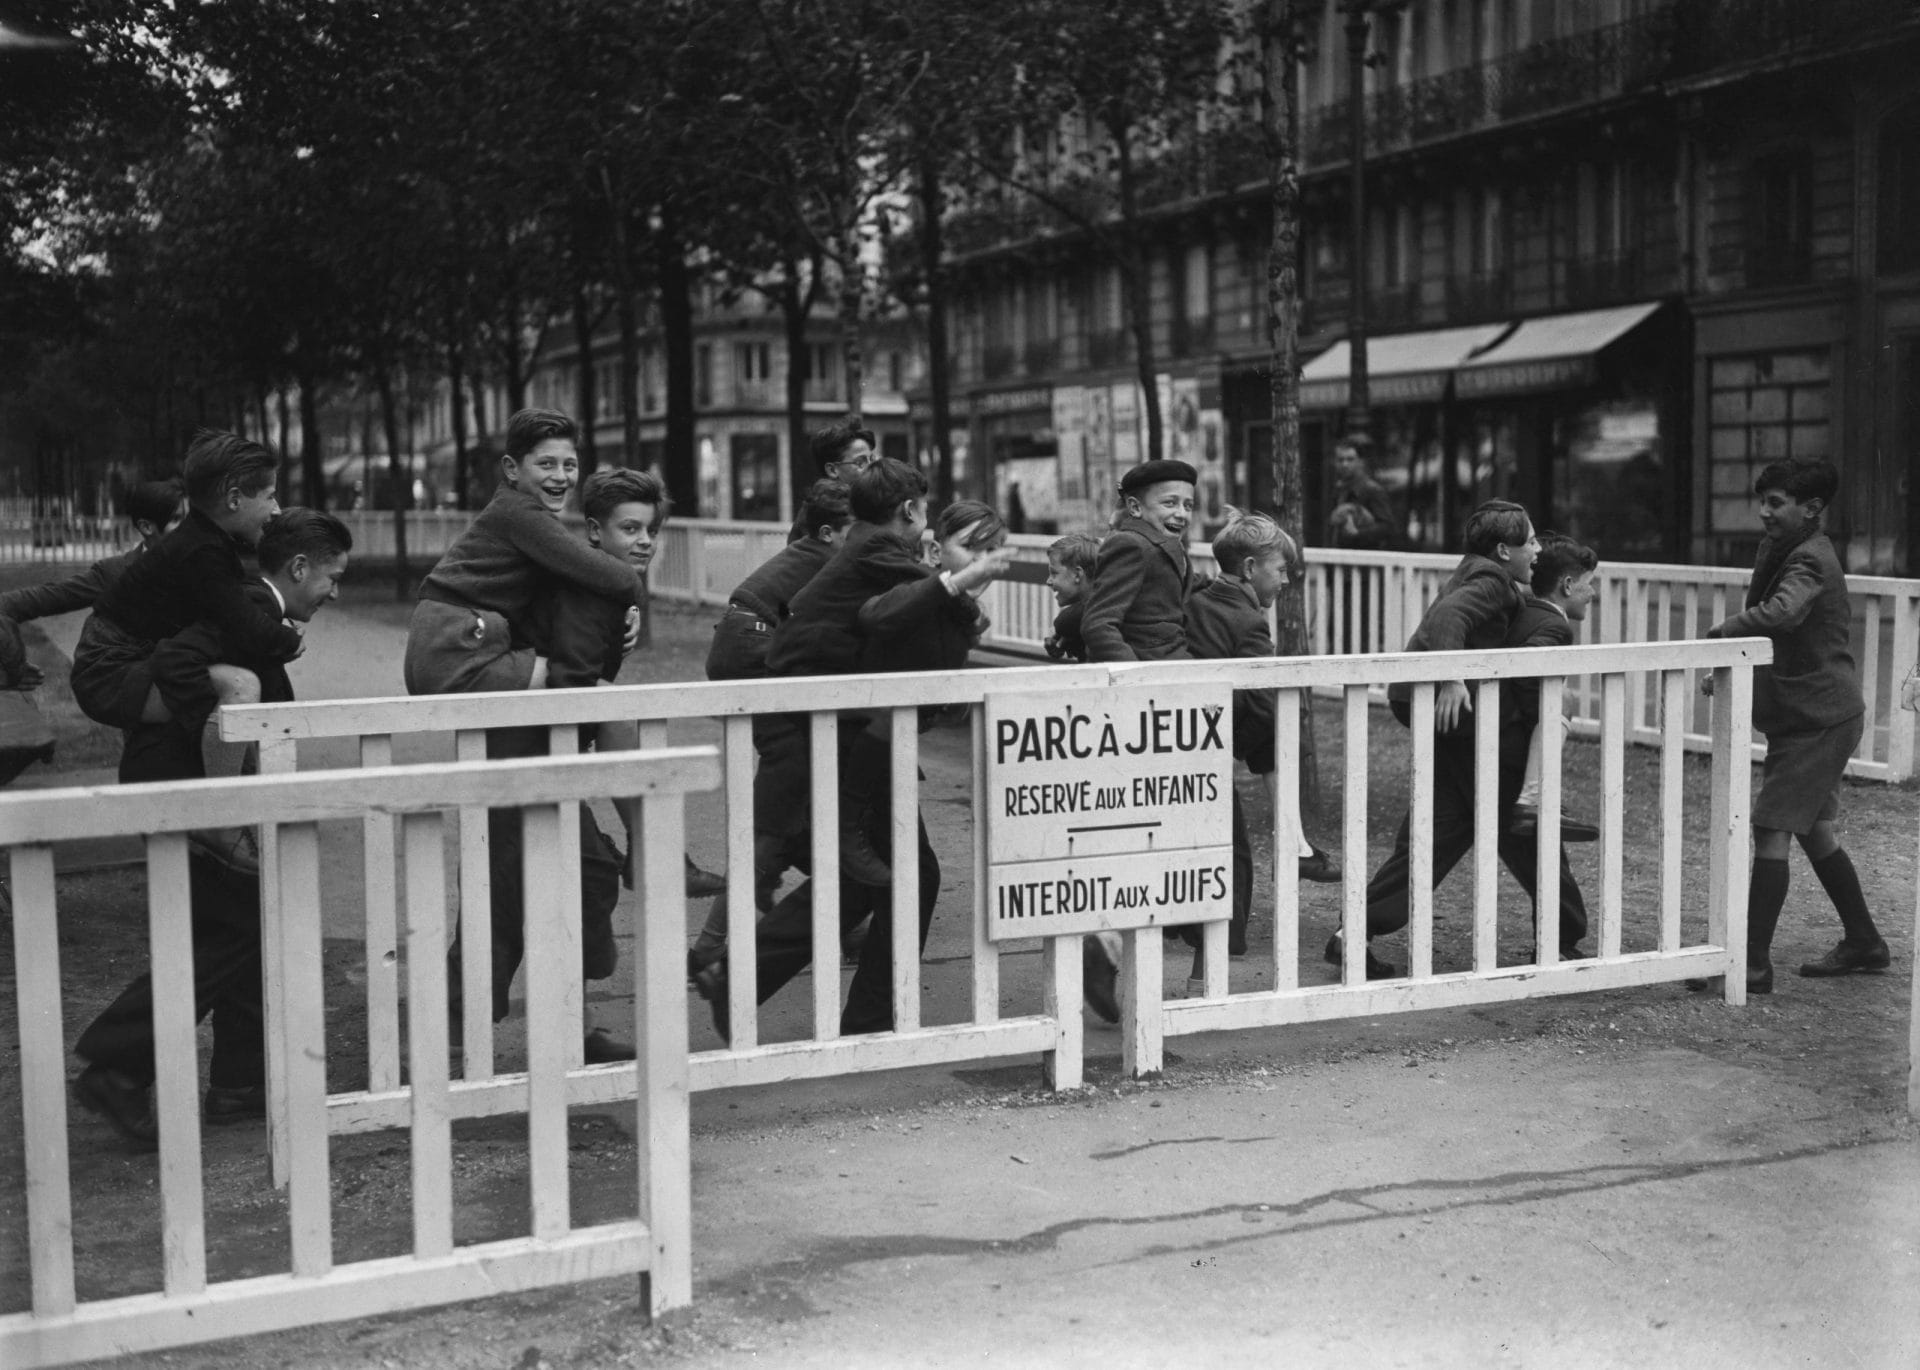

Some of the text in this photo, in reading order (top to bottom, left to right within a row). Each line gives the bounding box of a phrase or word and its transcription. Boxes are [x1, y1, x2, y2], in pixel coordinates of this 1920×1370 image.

[997, 707, 1224, 764] PARC À JEUX
[1005, 773, 1218, 817] RÉSERVÉ AUX ENFANTS
[999, 866, 1226, 919] INTERDIT AUX JUIFS
